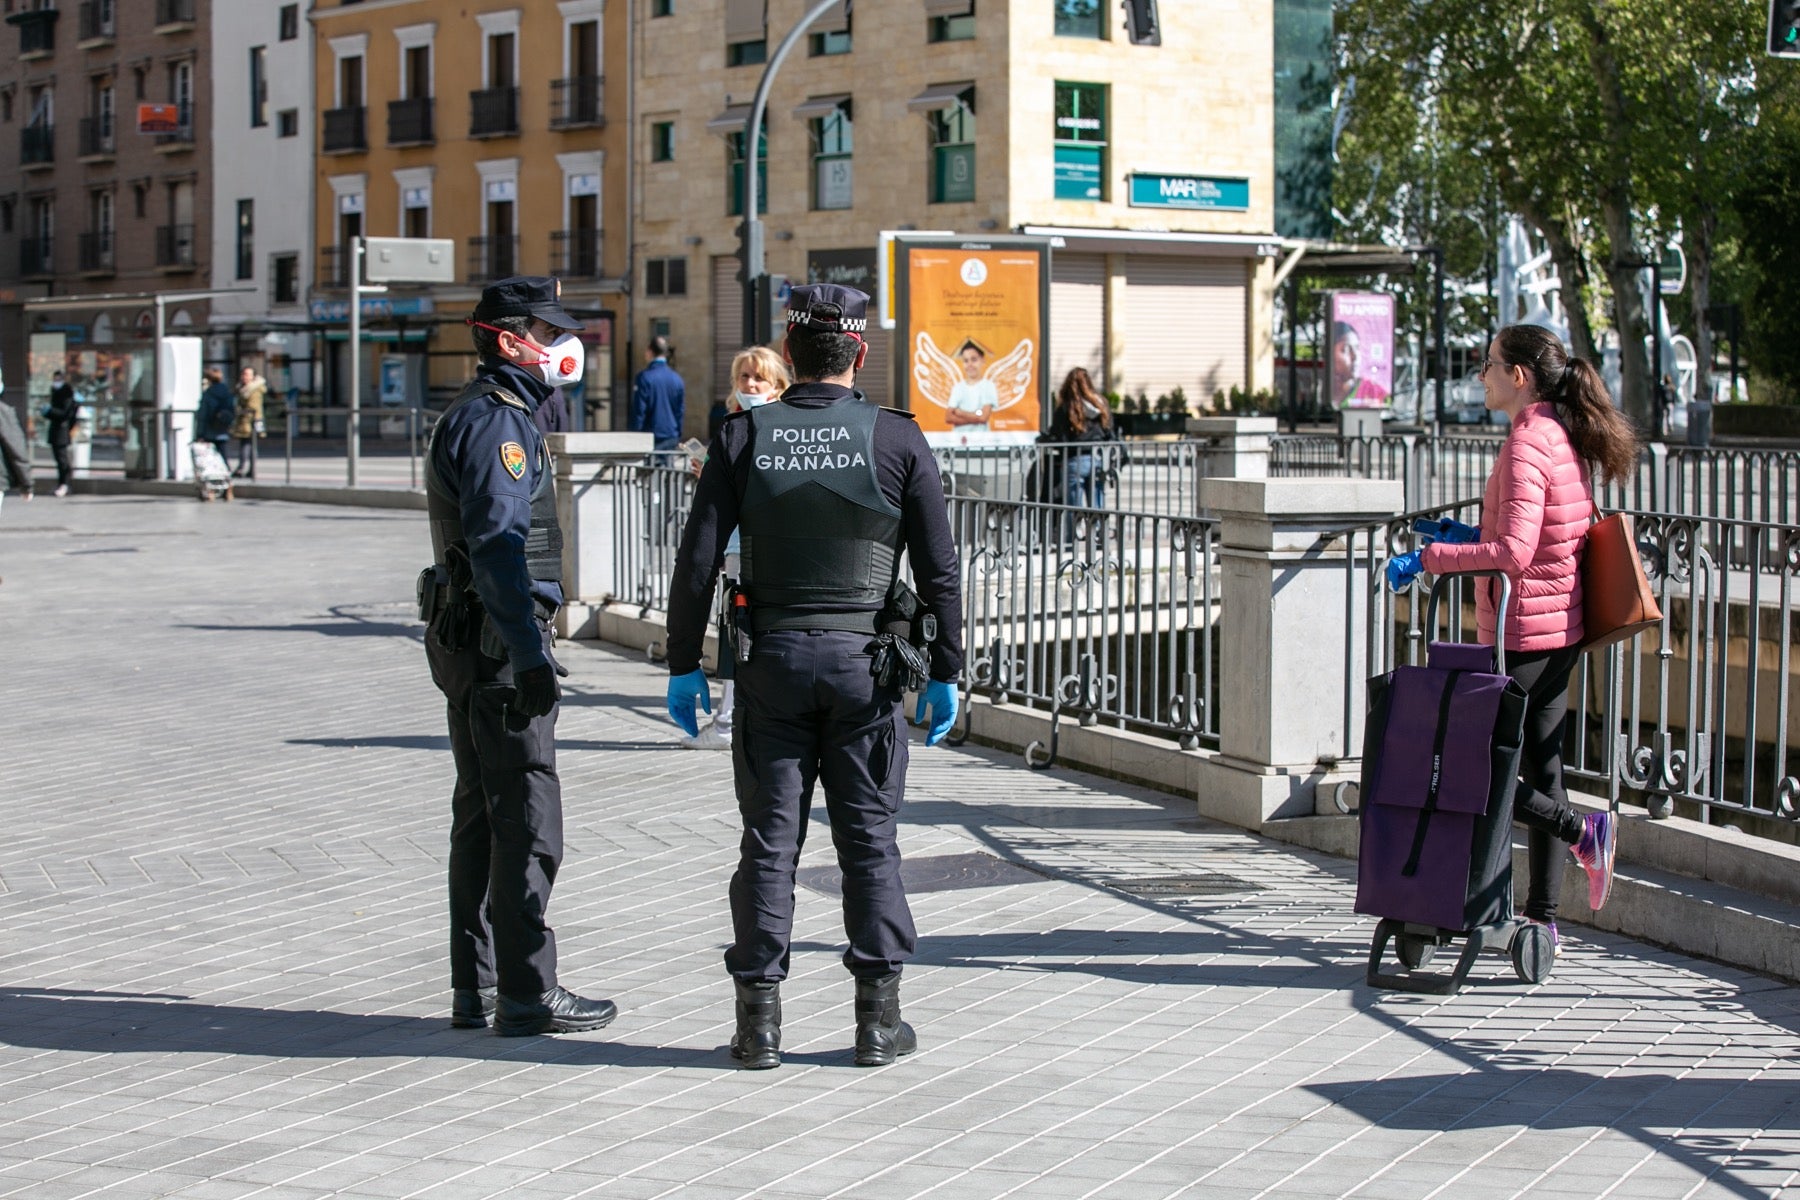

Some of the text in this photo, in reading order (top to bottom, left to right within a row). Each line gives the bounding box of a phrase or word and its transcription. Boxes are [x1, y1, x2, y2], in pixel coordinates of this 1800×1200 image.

[1160, 178, 1197, 197] MAR
[772, 426, 850, 443] POLICIA
[790, 444, 832, 454] LOCAL
[755, 452, 865, 471] GRANADA
